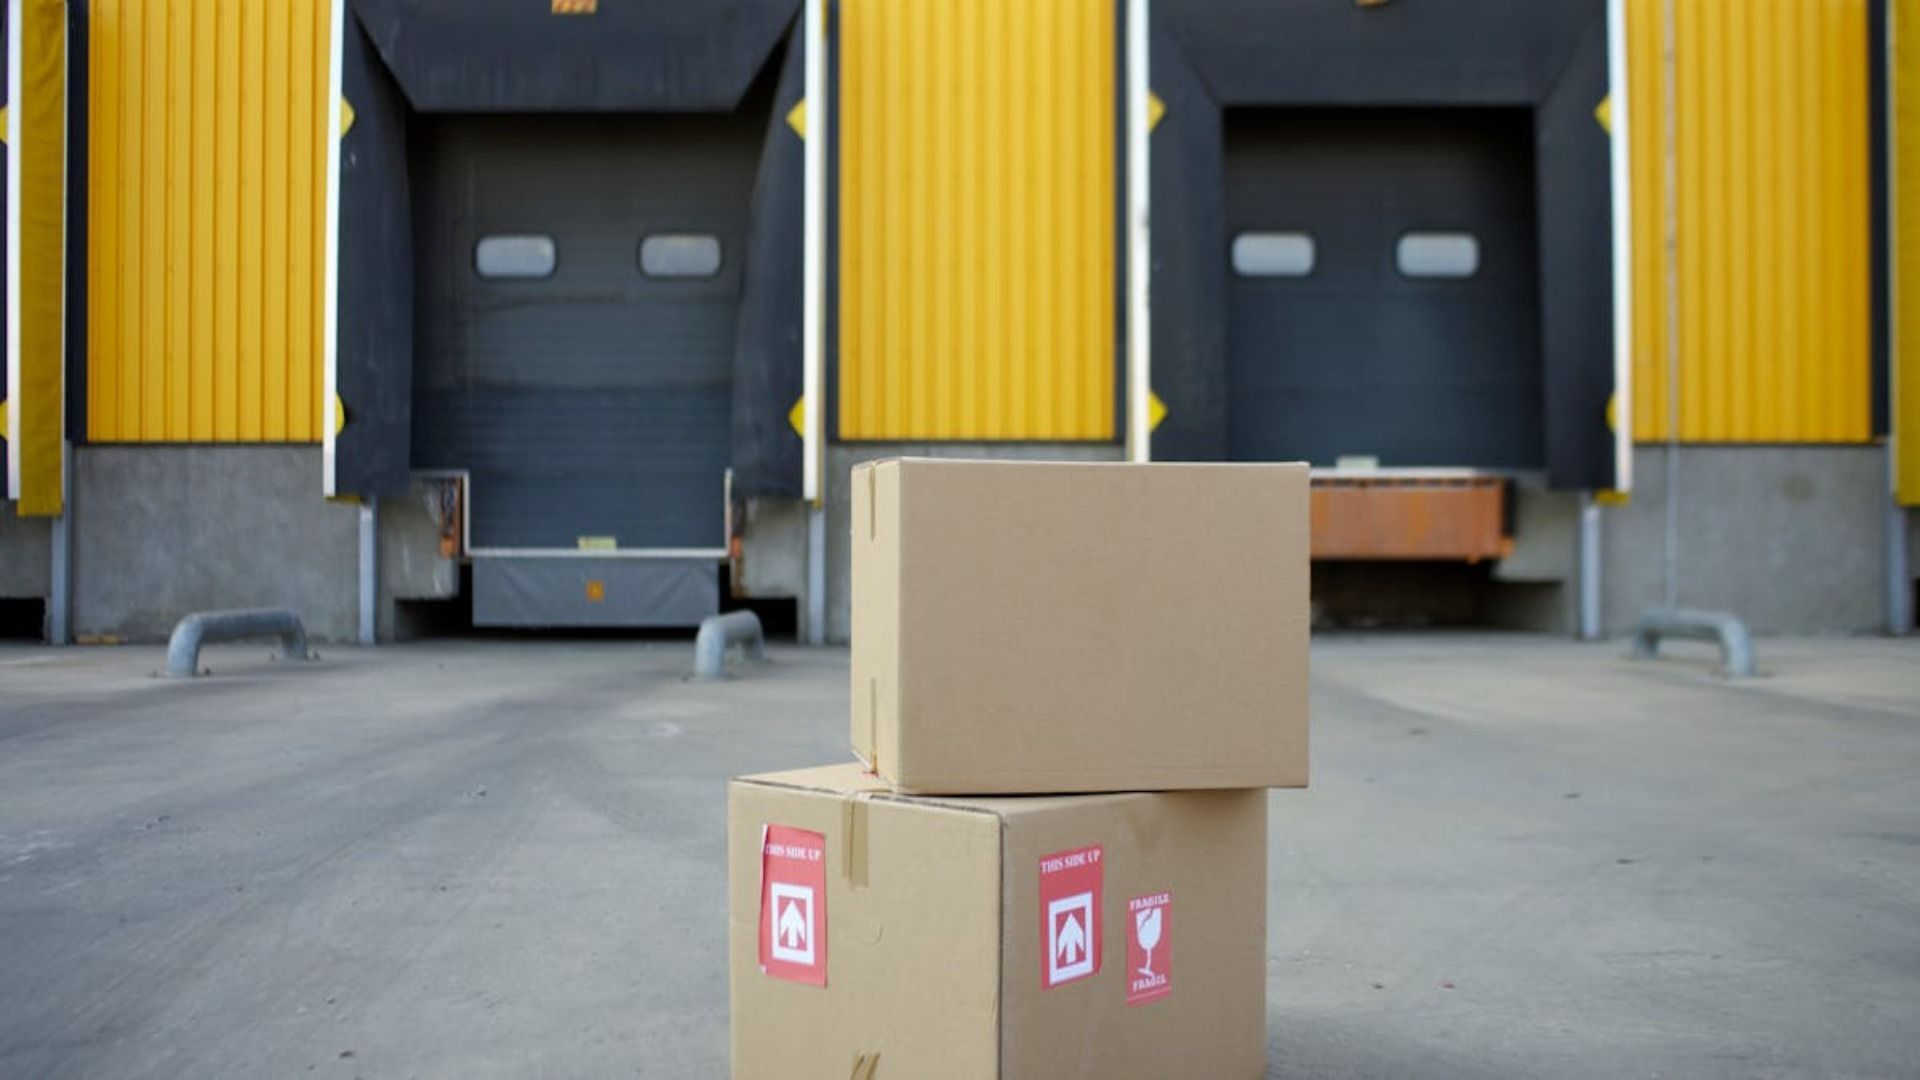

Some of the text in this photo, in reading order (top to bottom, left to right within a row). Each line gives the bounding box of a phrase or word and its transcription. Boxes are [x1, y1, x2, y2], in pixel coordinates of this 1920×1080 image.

[785, 846, 805, 859] SIDE
[808, 848, 821, 860] UP
[1041, 849, 1101, 874] THIS SIDE UP
[1130, 893, 1170, 911] FRAGILE
